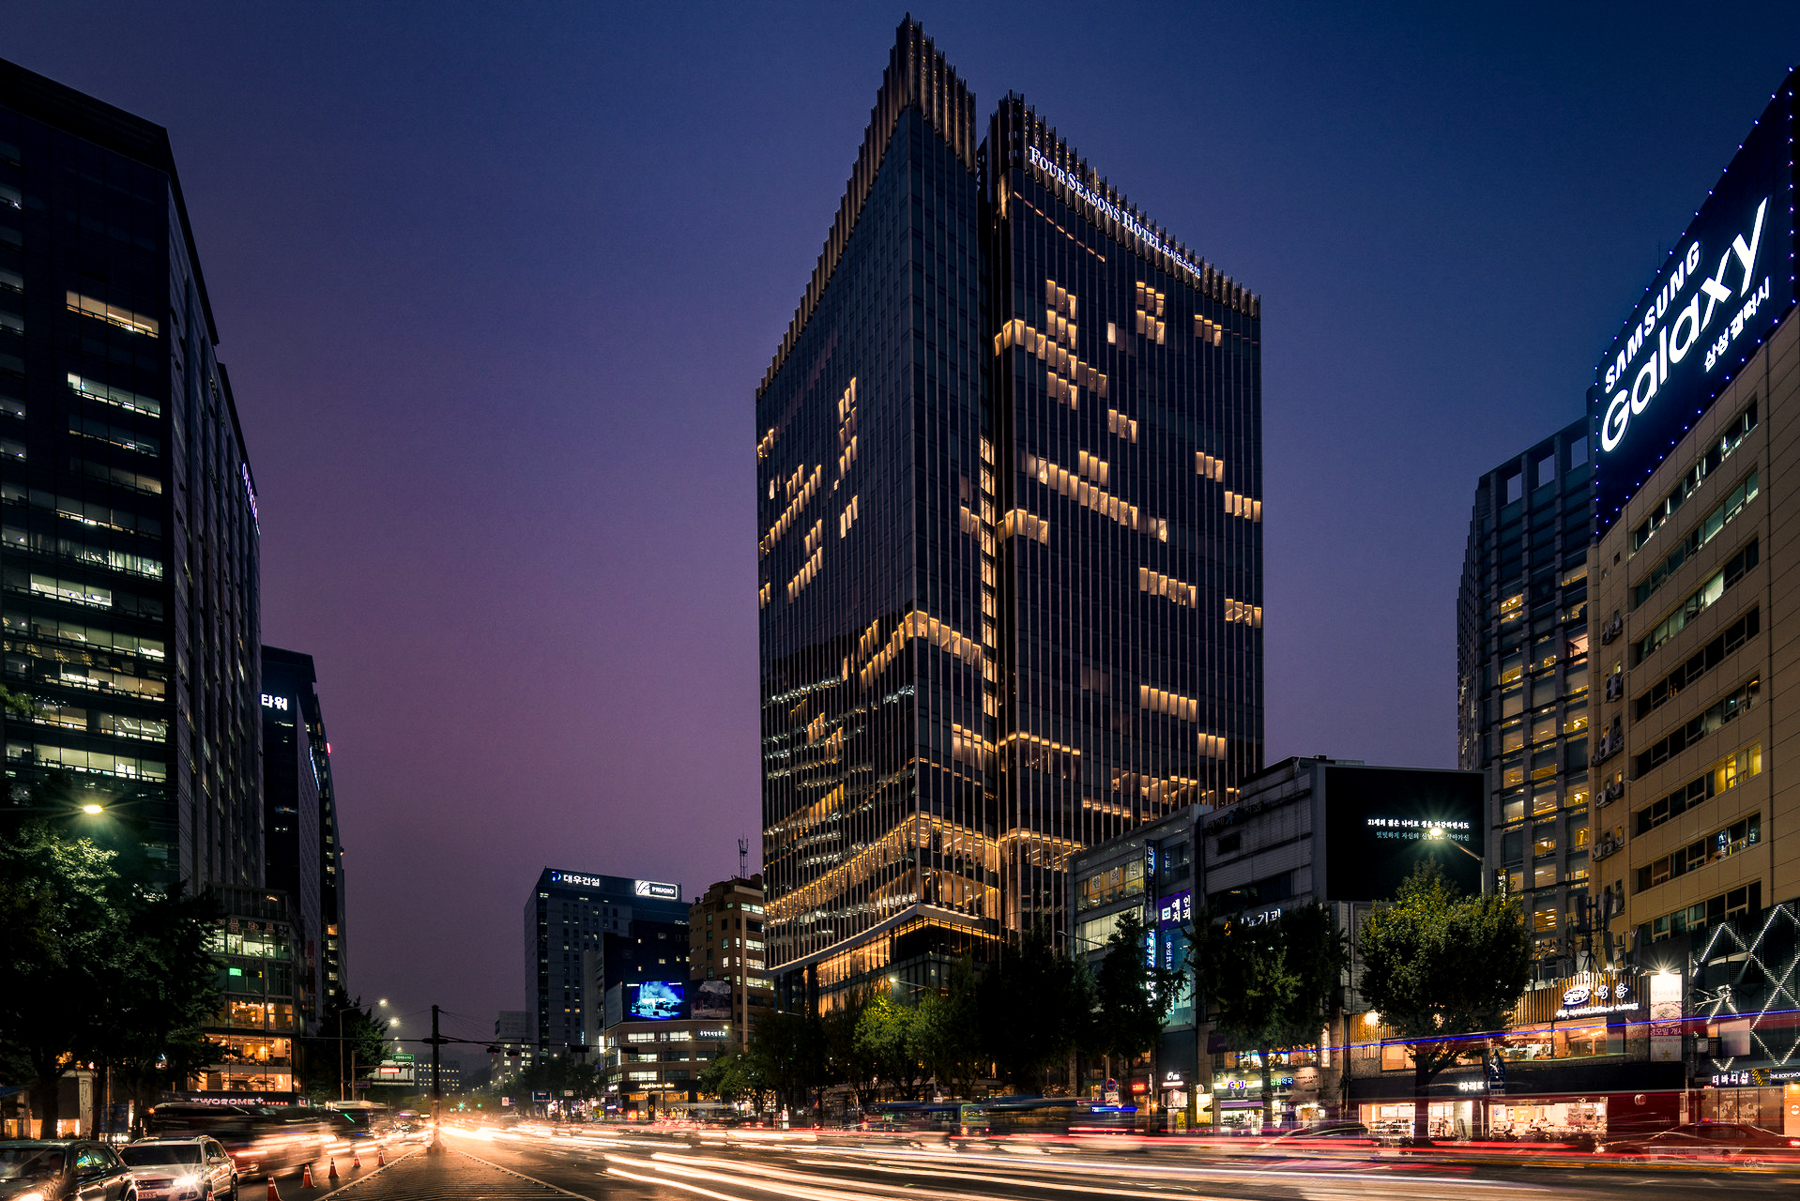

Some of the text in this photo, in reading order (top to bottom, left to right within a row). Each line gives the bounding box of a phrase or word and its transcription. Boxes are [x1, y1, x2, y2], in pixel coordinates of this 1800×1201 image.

[1029, 146, 1163, 252] FOUR SEASONS HOTEL
[1601, 196, 1768, 453] Galaxy
[1605, 240, 1700, 394] SAMSUNG
[260, 693, 288, 711] 타워
[563, 874, 600, 887] 대우건설
[1712, 1072, 1749, 1085] 더바디샵
